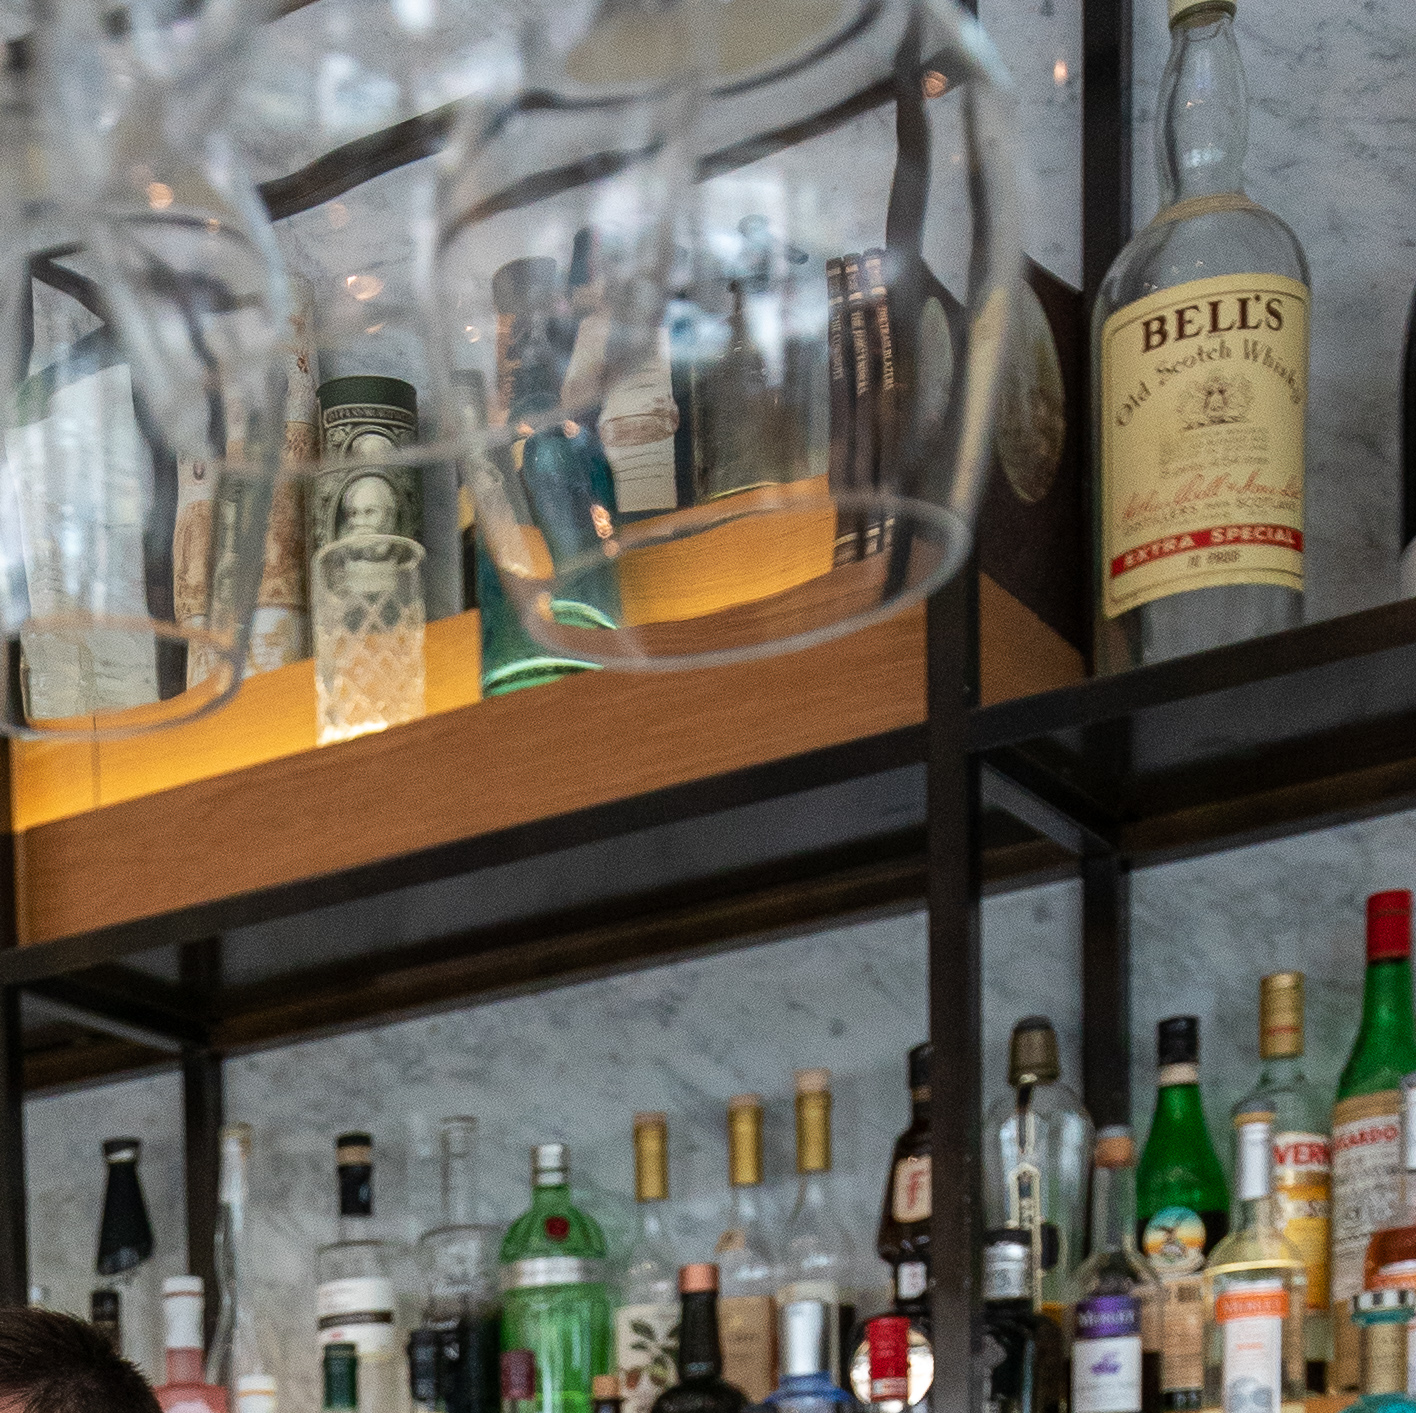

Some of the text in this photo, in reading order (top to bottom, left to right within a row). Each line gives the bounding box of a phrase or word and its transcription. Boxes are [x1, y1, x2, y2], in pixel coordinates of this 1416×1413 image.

[1140, 294, 1285, 354] BELL'S
[1115, 380, 1152, 427] Old
[1155, 340, 1232, 387] Scotch
[1123, 535, 1196, 568] EXTRA
[1210, 526, 1295, 554] SPECIAL
